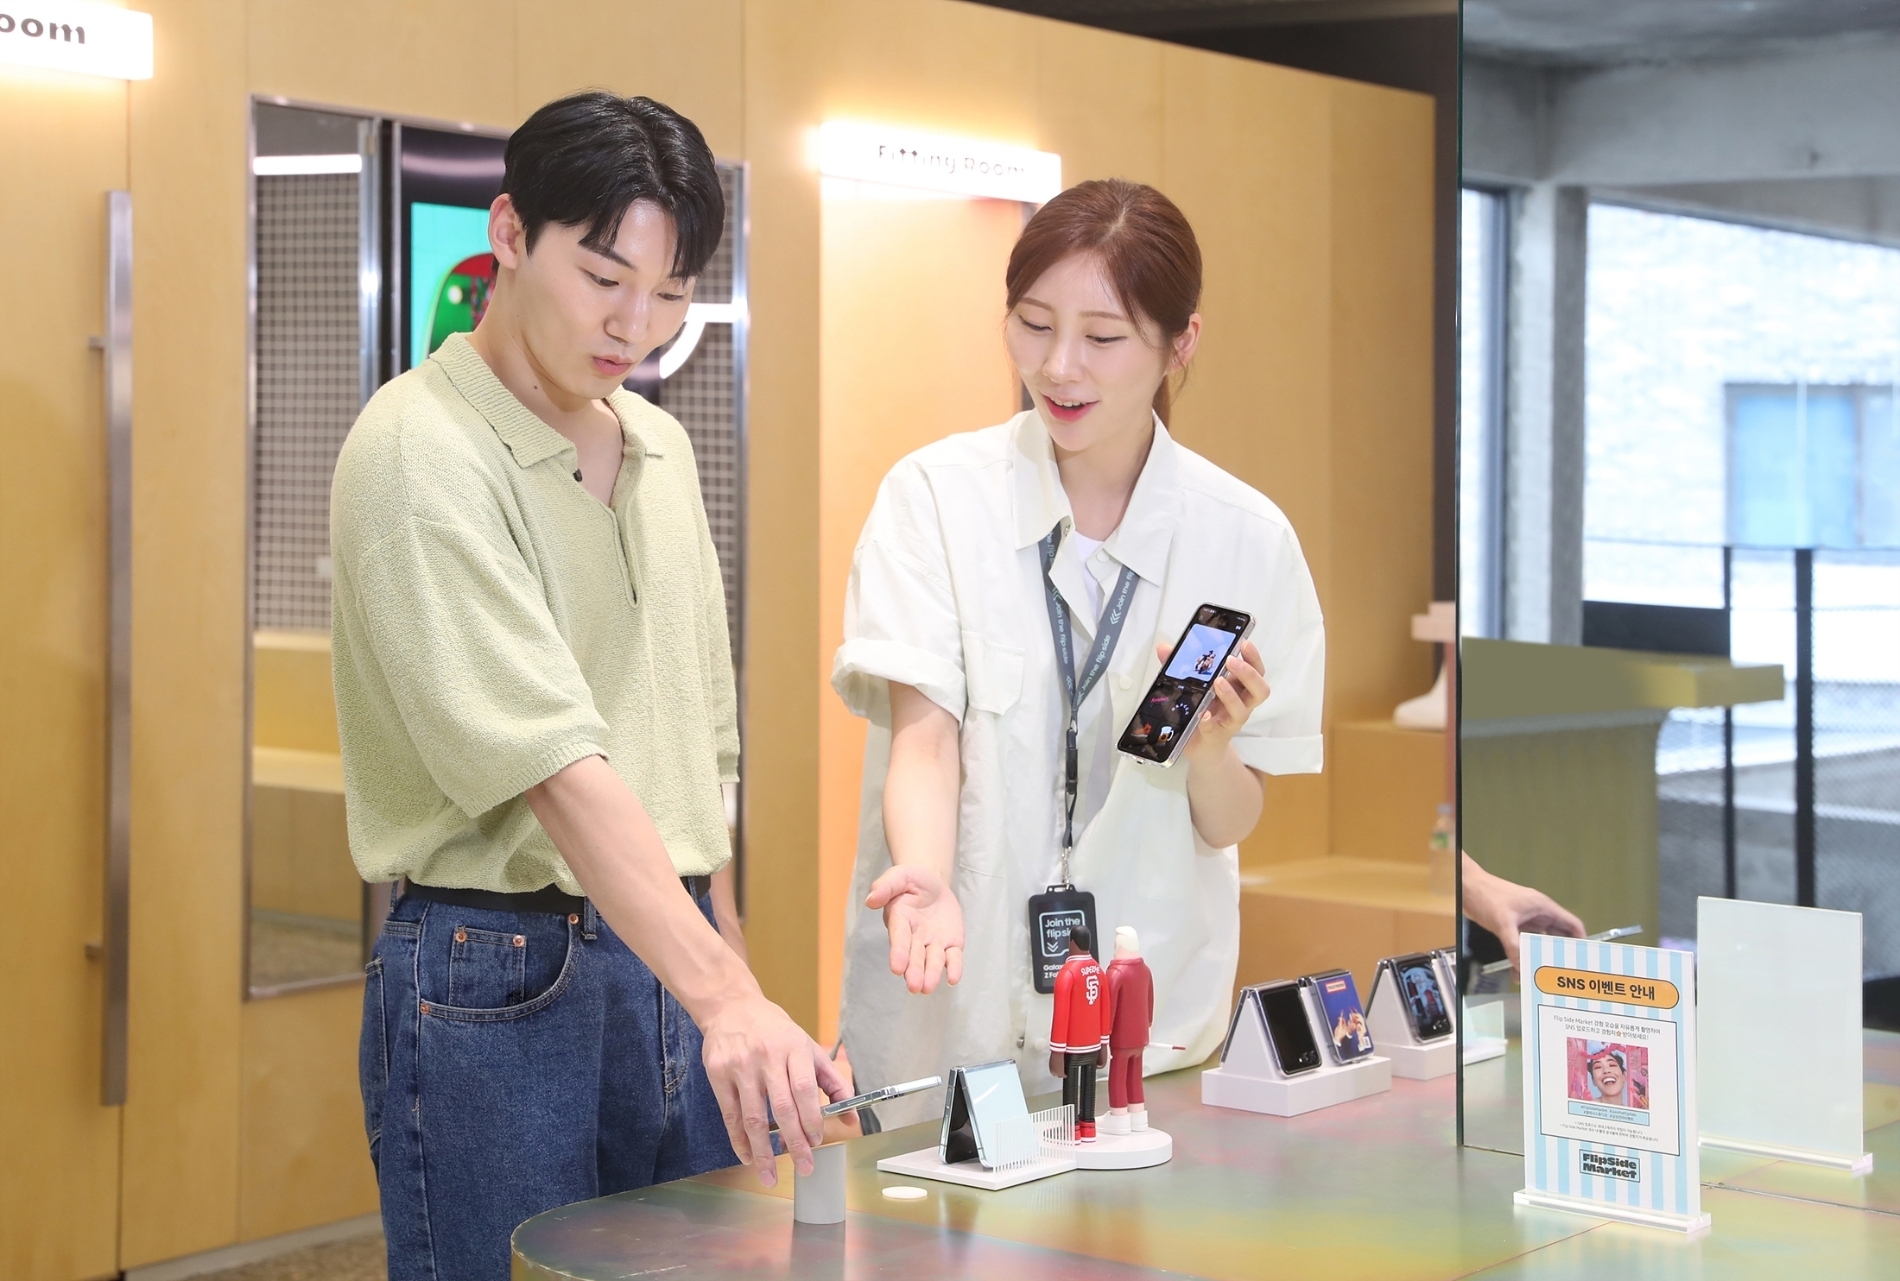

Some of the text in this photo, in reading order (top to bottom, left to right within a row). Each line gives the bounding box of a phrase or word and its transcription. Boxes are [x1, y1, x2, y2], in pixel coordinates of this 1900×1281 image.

[878, 145, 1030, 177] Fitting Room
[1116, 594, 1126, 610] Join
[1122, 581, 1131, 594] the
[1055, 602, 1063, 618] Join
[1082, 634, 1111, 691] Join the flip side
[1044, 917, 1081, 927] Join the
[1046, 929, 1061, 940] flip
[1557, 976, 1656, 1001] SNS 이벤트 안내
[1554, 1015, 1563, 1023] Flip
[1575, 1018, 1593, 1026] Market
[1565, 1023, 1576, 1031] SNS
[1582, 1152, 1637, 1170] FlipSide
[1582, 1163, 1637, 1179] Market
